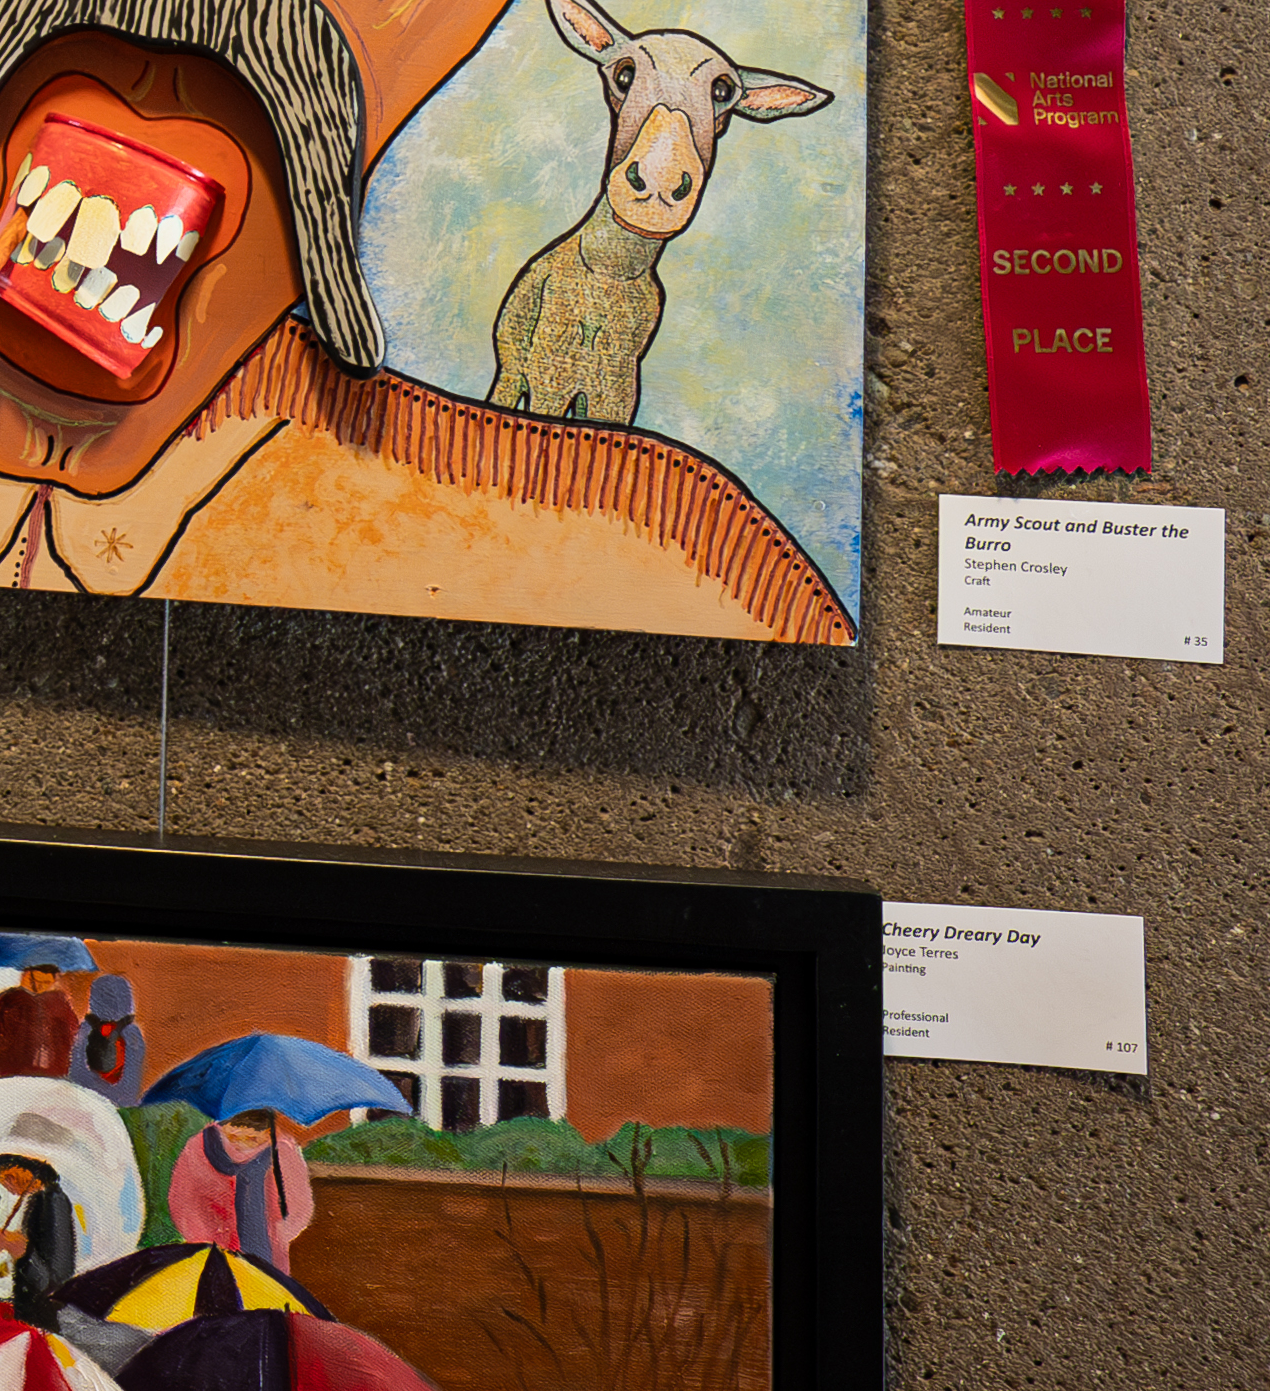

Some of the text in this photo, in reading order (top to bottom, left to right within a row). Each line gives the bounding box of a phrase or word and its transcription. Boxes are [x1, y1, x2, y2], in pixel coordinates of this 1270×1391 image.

[1030, 71, 1114, 89] National
[1032, 89, 1074, 107] Arts
[1033, 108, 1120, 128] Program
[992, 248, 1123, 275] SECOND
[1012, 328, 1114, 354] PLACE
[964, 513, 1190, 539] Army Scout and Buster the
[964, 536, 1012, 552] Burro
[964, 558, 1068, 577] Stephen Crosley
[964, 575, 991, 587] Craft
[963, 606, 1012, 618] Amateur
[963, 622, 1011, 634] Resident
[1194, 636, 1209, 647] 35
[882, 922, 1041, 948] Cheery Dreary Day
[882, 945, 959, 960] Joyce Terres
[882, 962, 927, 976] Painting
[882, 1009, 949, 1023] Professional
[882, 1026, 930, 1038] Resident
[1117, 1041, 1139, 1053] 107
